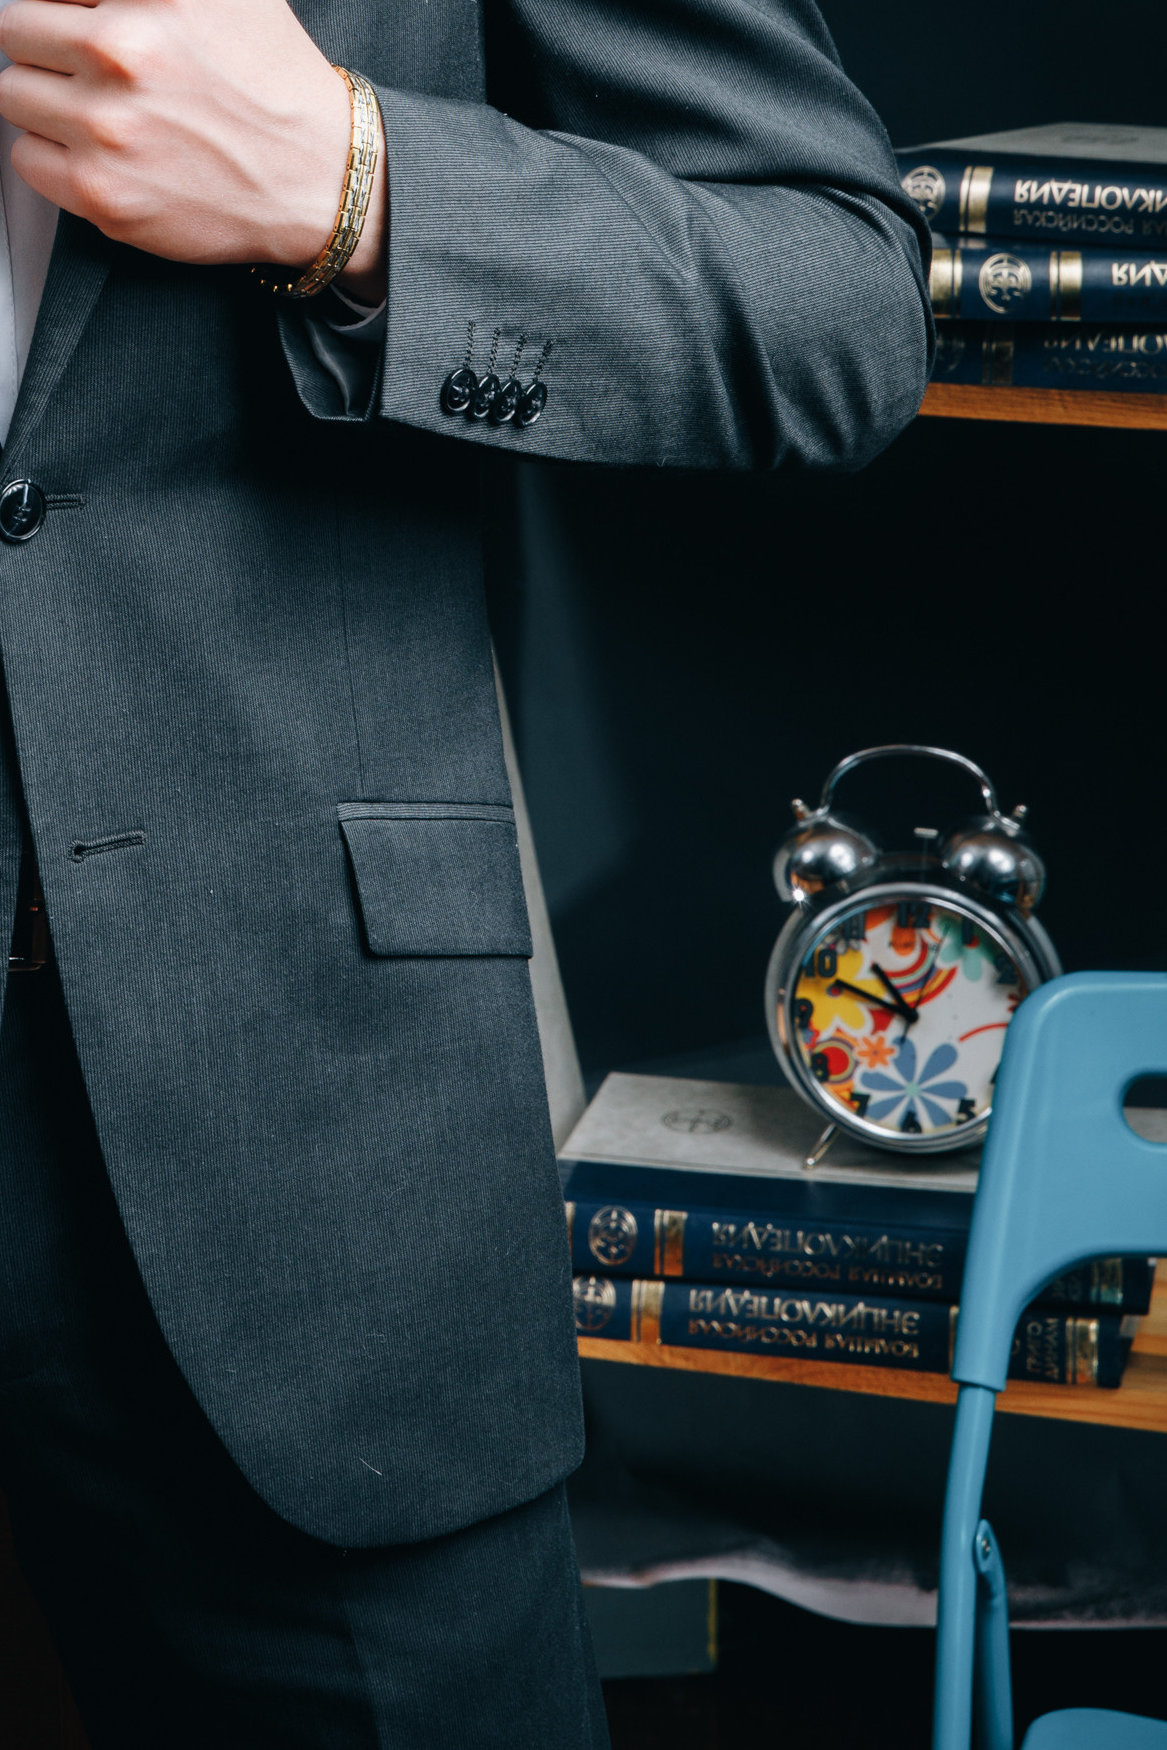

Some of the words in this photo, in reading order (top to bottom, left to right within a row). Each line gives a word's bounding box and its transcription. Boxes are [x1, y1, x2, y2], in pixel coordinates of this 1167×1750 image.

[1013, 208, 1134, 235] РОССИЙСКАЯ
[897, 903, 931, 928] 12
[802, 948, 838, 979] 10
[957, 1099, 977, 1125] 5
[712, 1222, 944, 1267] ЭНЦИКЛОПЕДИЯ
[689, 1288, 920, 1334] ЭНЦИКЛОПЕДИЯ
[688, 1319, 818, 1349] РОССИЙСКАЯ
